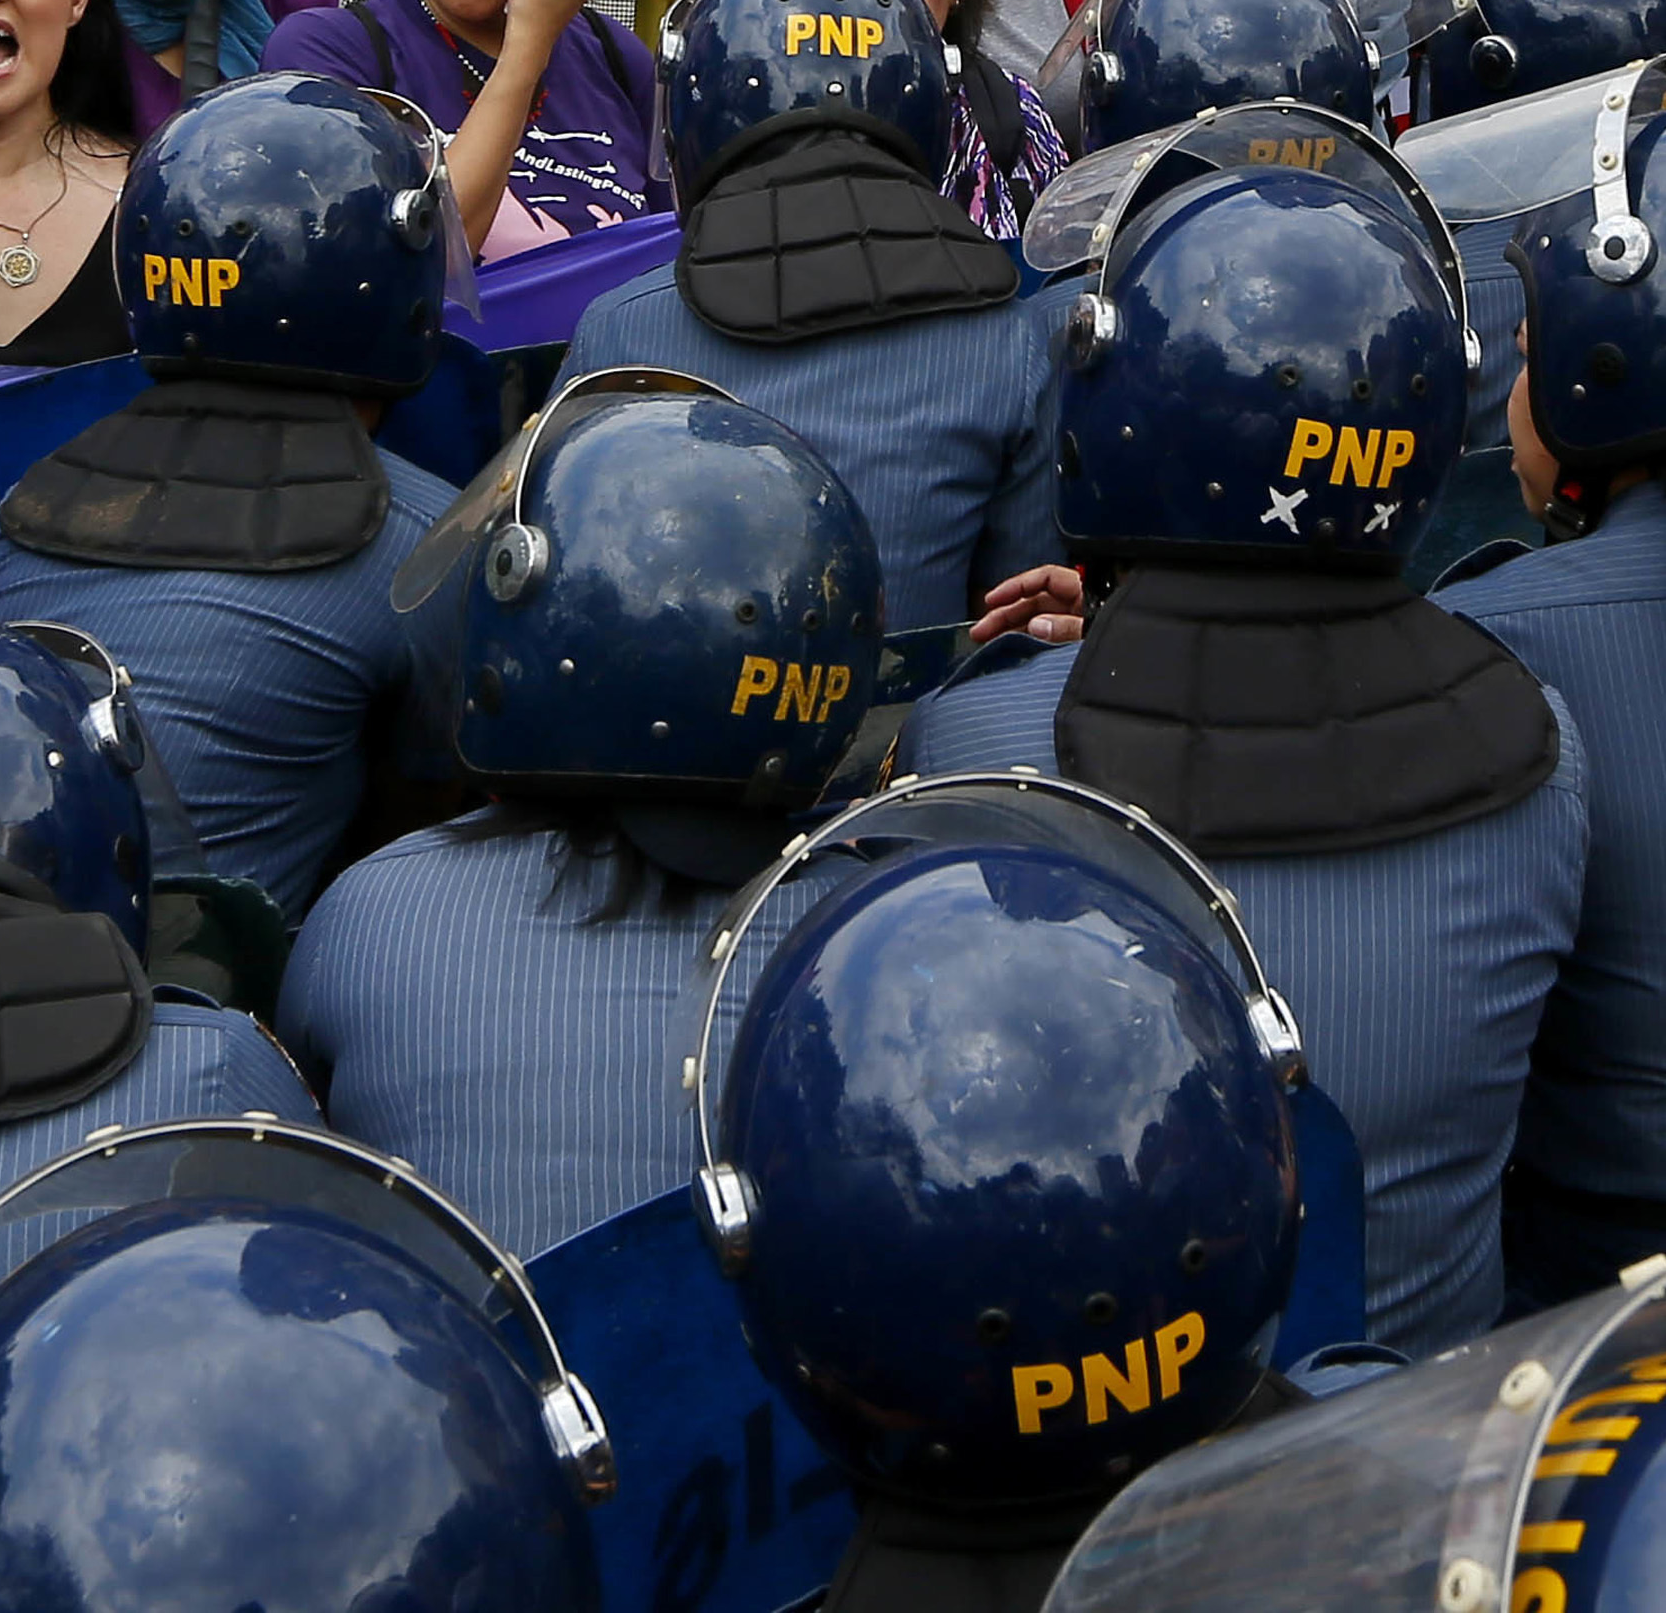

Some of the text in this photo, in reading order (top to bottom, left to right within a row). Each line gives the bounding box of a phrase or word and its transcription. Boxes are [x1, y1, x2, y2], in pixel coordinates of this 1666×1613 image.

[785, 13, 885, 60] PNP
[143, 253, 241, 309] PNP
[1283, 416, 1416, 490] PNP
[729, 655, 851, 726] PNP
[1010, 1310, 1206, 1434] PNP
